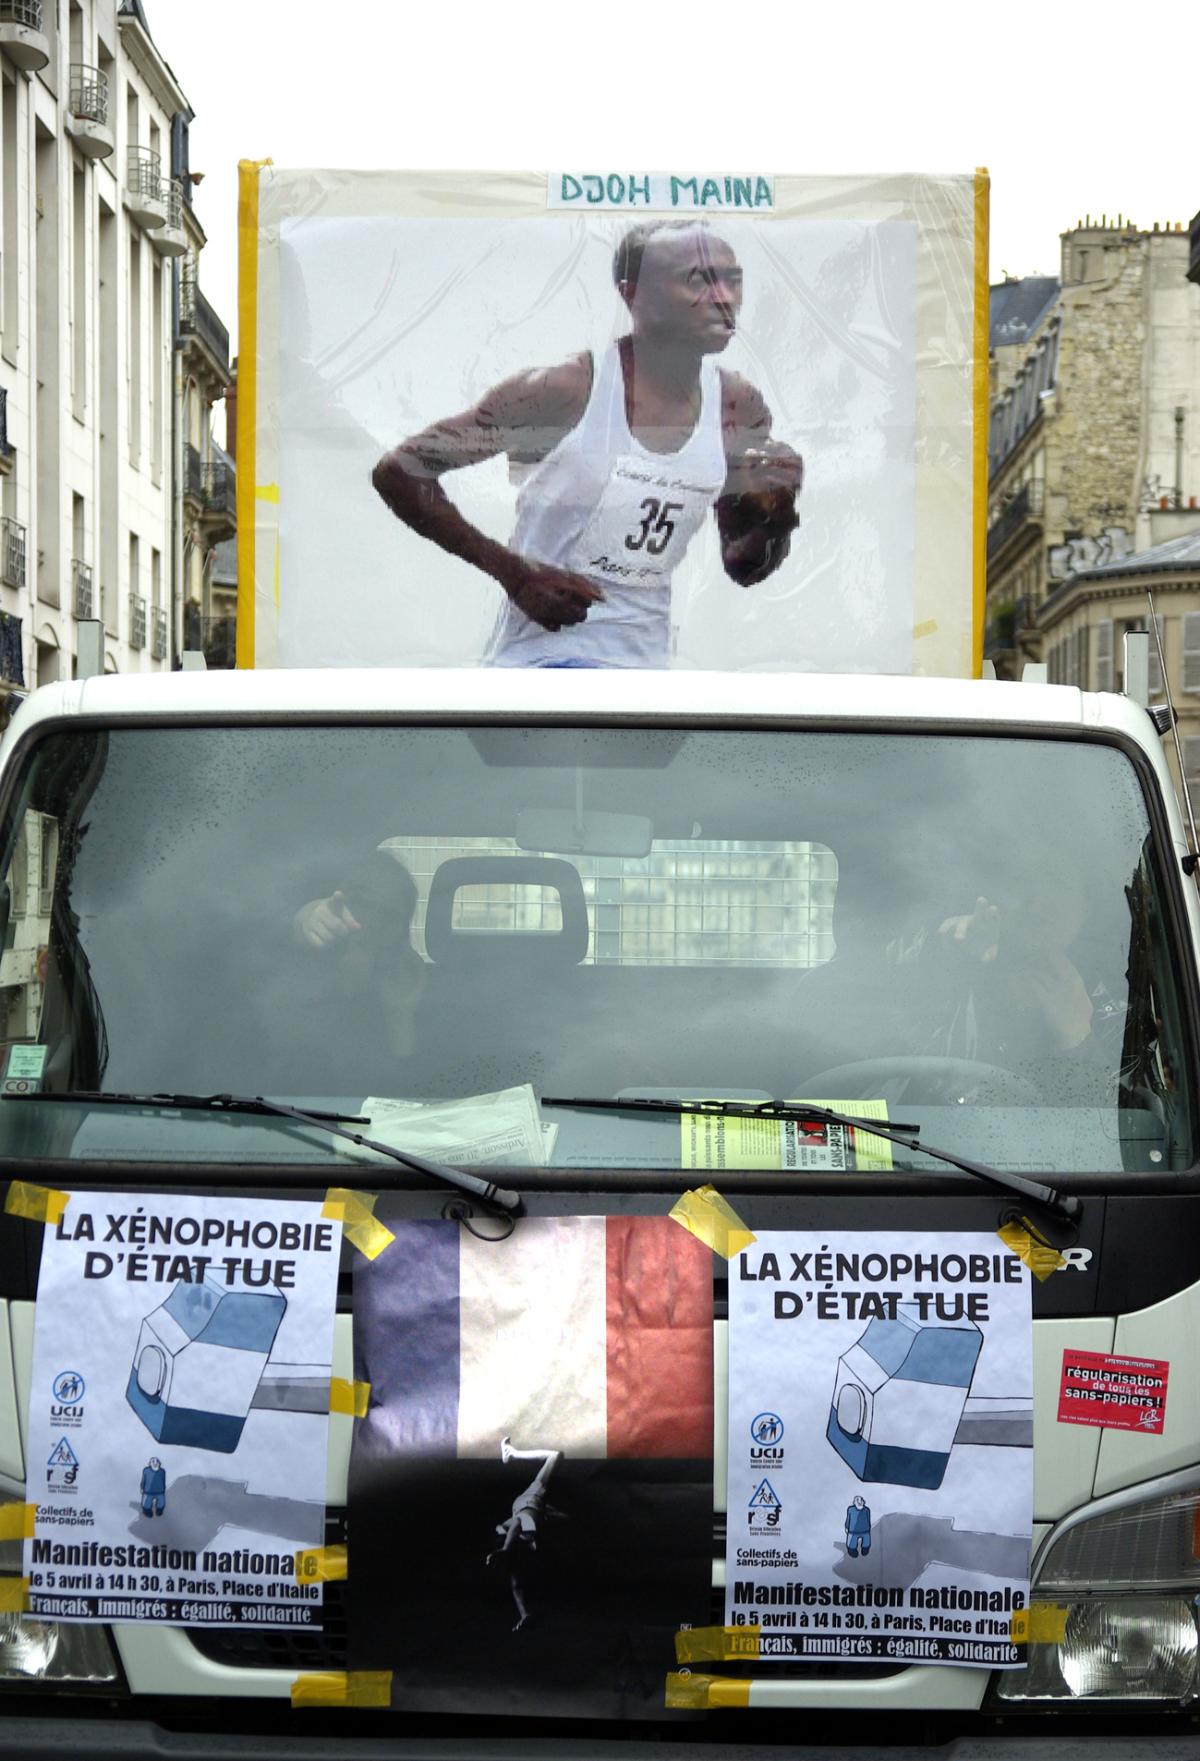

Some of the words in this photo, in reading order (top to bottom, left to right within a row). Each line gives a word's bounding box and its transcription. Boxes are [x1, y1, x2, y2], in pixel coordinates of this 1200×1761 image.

[561, 173, 650, 205] DJOH
[670, 175, 773, 207] MAINA
[624, 497, 685, 556] 35
[56, 1213, 95, 1241] LA
[103, 1207, 333, 1252] XÉNOPHOBIE
[222, 1257, 296, 1288] TUE
[740, 1253, 781, 1281] LA
[789, 1245, 1023, 1283] XÉNOPHOBIE
[913, 1292, 990, 1321] TUE
[1066, 1366, 1163, 1388] régularisation
[1092, 1381, 1106, 1391] de
[1108, 1383, 1132, 1394] tous
[1134, 1385, 1150, 1396] les
[1065, 1388, 1154, 1407] sans-papiers
[51, 1405, 84, 1417] UCIJ
[750, 1447, 785, 1459] UCIJ
[34, 1515, 95, 1527] sans-papiers
[35, 1505, 77, 1517] Collectifs
[79, 1507, 94, 1518] de
[32, 1538, 197, 1572] Manifestation
[202, 1549, 319, 1577] nationale
[736, 1548, 781, 1559] Collectifs
[783, 1549, 798, 1559] de
[736, 1558, 799, 1569] sans-papiers
[29, 1571, 43, 1587] le
[46, 1571, 56, 1588] 5
[58, 1573, 92, 1590] avril
[95, 1573, 105, 1590] à
[108, 1574, 125, 1591] 14
[127, 1575, 137, 1591] h
[140, 1575, 163, 1593] 30,
[165, 1576, 176, 1593] à
[178, 1577, 219, 1597] Paris,
[222, 1580, 264, 1598] Place
[734, 1581, 904, 1608] Manifestation
[909, 1585, 1025, 1613] nationale
[30, 1595, 94, 1618] Français,
[98, 1599, 168, 1619] immigrés
[181, 1601, 237, 1622] égalité,
[241, 1604, 312, 1624] solidarité
[731, 1611, 746, 1626] le
[749, 1611, 759, 1626] 5
[762, 1612, 797, 1628] avril
[800, 1611, 809, 1628] à
[812, 1613, 829, 1629] 14
[832, 1613, 842, 1629] h
[845, 1613, 868, 1630] 30,
[871, 1613, 881, 1630] à
[883, 1614, 926, 1632] Paris,
[929, 1616, 972, 1633] Place
[731, 1636, 797, 1656] Français,
[802, 1636, 873, 1656] immigrés
[886, 1637, 943, 1658] égalité,
[947, 1642, 1018, 1661] solidarité
